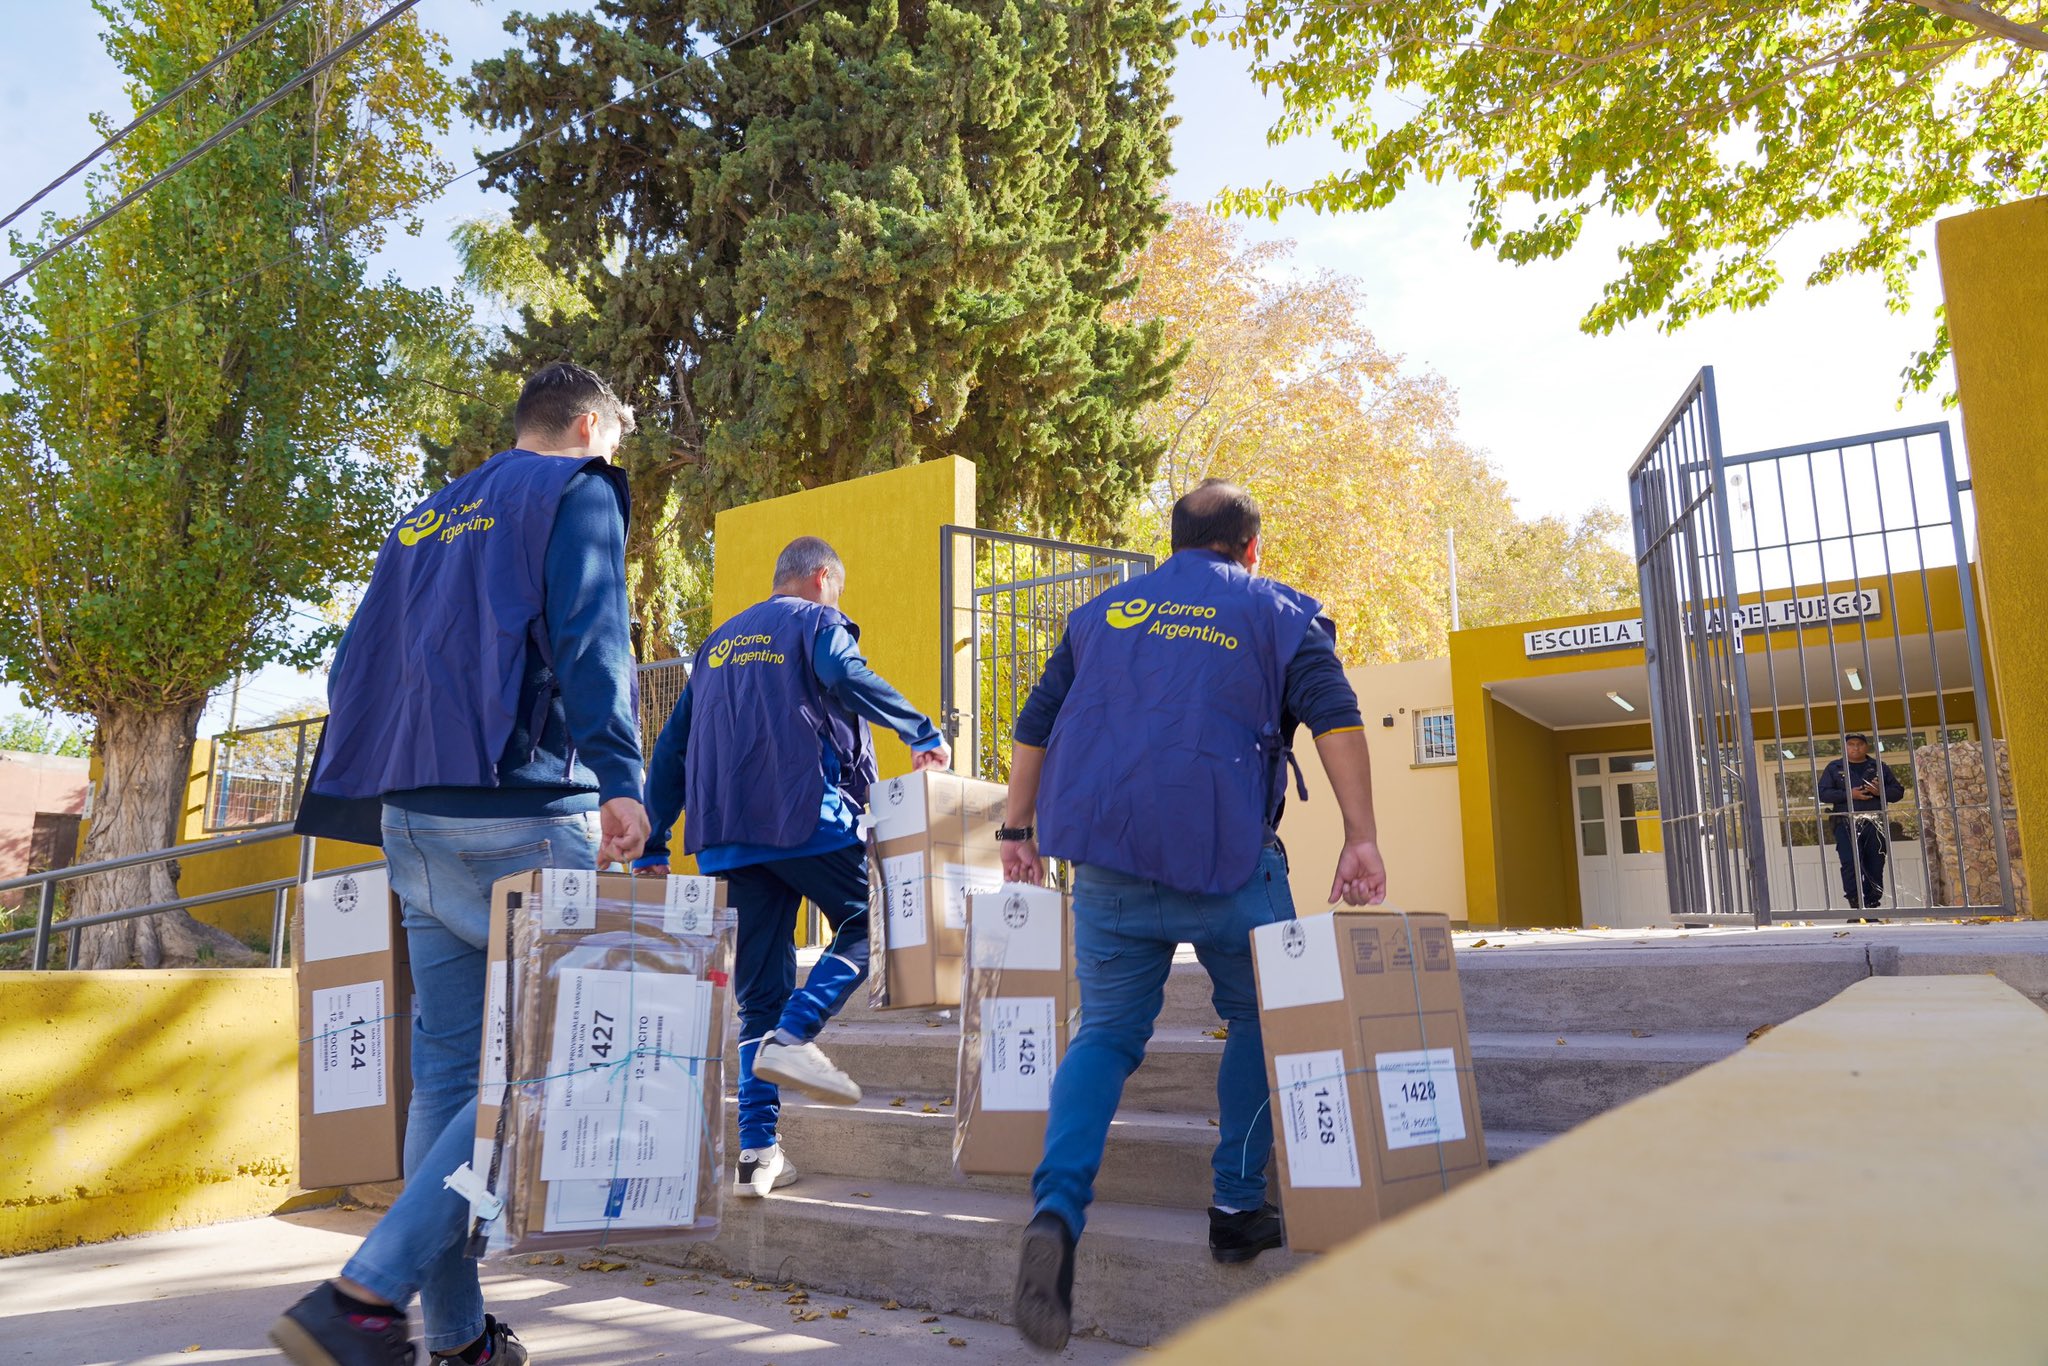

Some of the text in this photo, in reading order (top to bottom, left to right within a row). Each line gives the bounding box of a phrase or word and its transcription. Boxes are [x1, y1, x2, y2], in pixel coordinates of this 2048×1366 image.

[437, 515, 495, 544] rgentino
[1158, 601, 1216, 619] Correo
[1531, 623, 1631, 651] ESCUELA
[1784, 594, 1871, 621] FUEGO
[733, 634, 771, 647] Correo
[1147, 620, 1238, 650] Argentino
[730, 649, 785, 665] Argentino
[902, 879, 913, 918] 1423
[330, 1012, 337, 1022] 12
[330, 1031, 338, 1067] POCITO
[350, 1015, 366, 1070] 1424
[569, 1010, 579, 1061] PROVINCIALES
[589, 1010, 614, 1073] 1427
[637, 1015, 648, 1058] POCITO
[1019, 1028, 1036, 1076] 1426
[636, 1068, 645, 1081] 12
[1401, 1080, 1436, 1103] 1428
[1314, 1086, 1336, 1146] 1428
